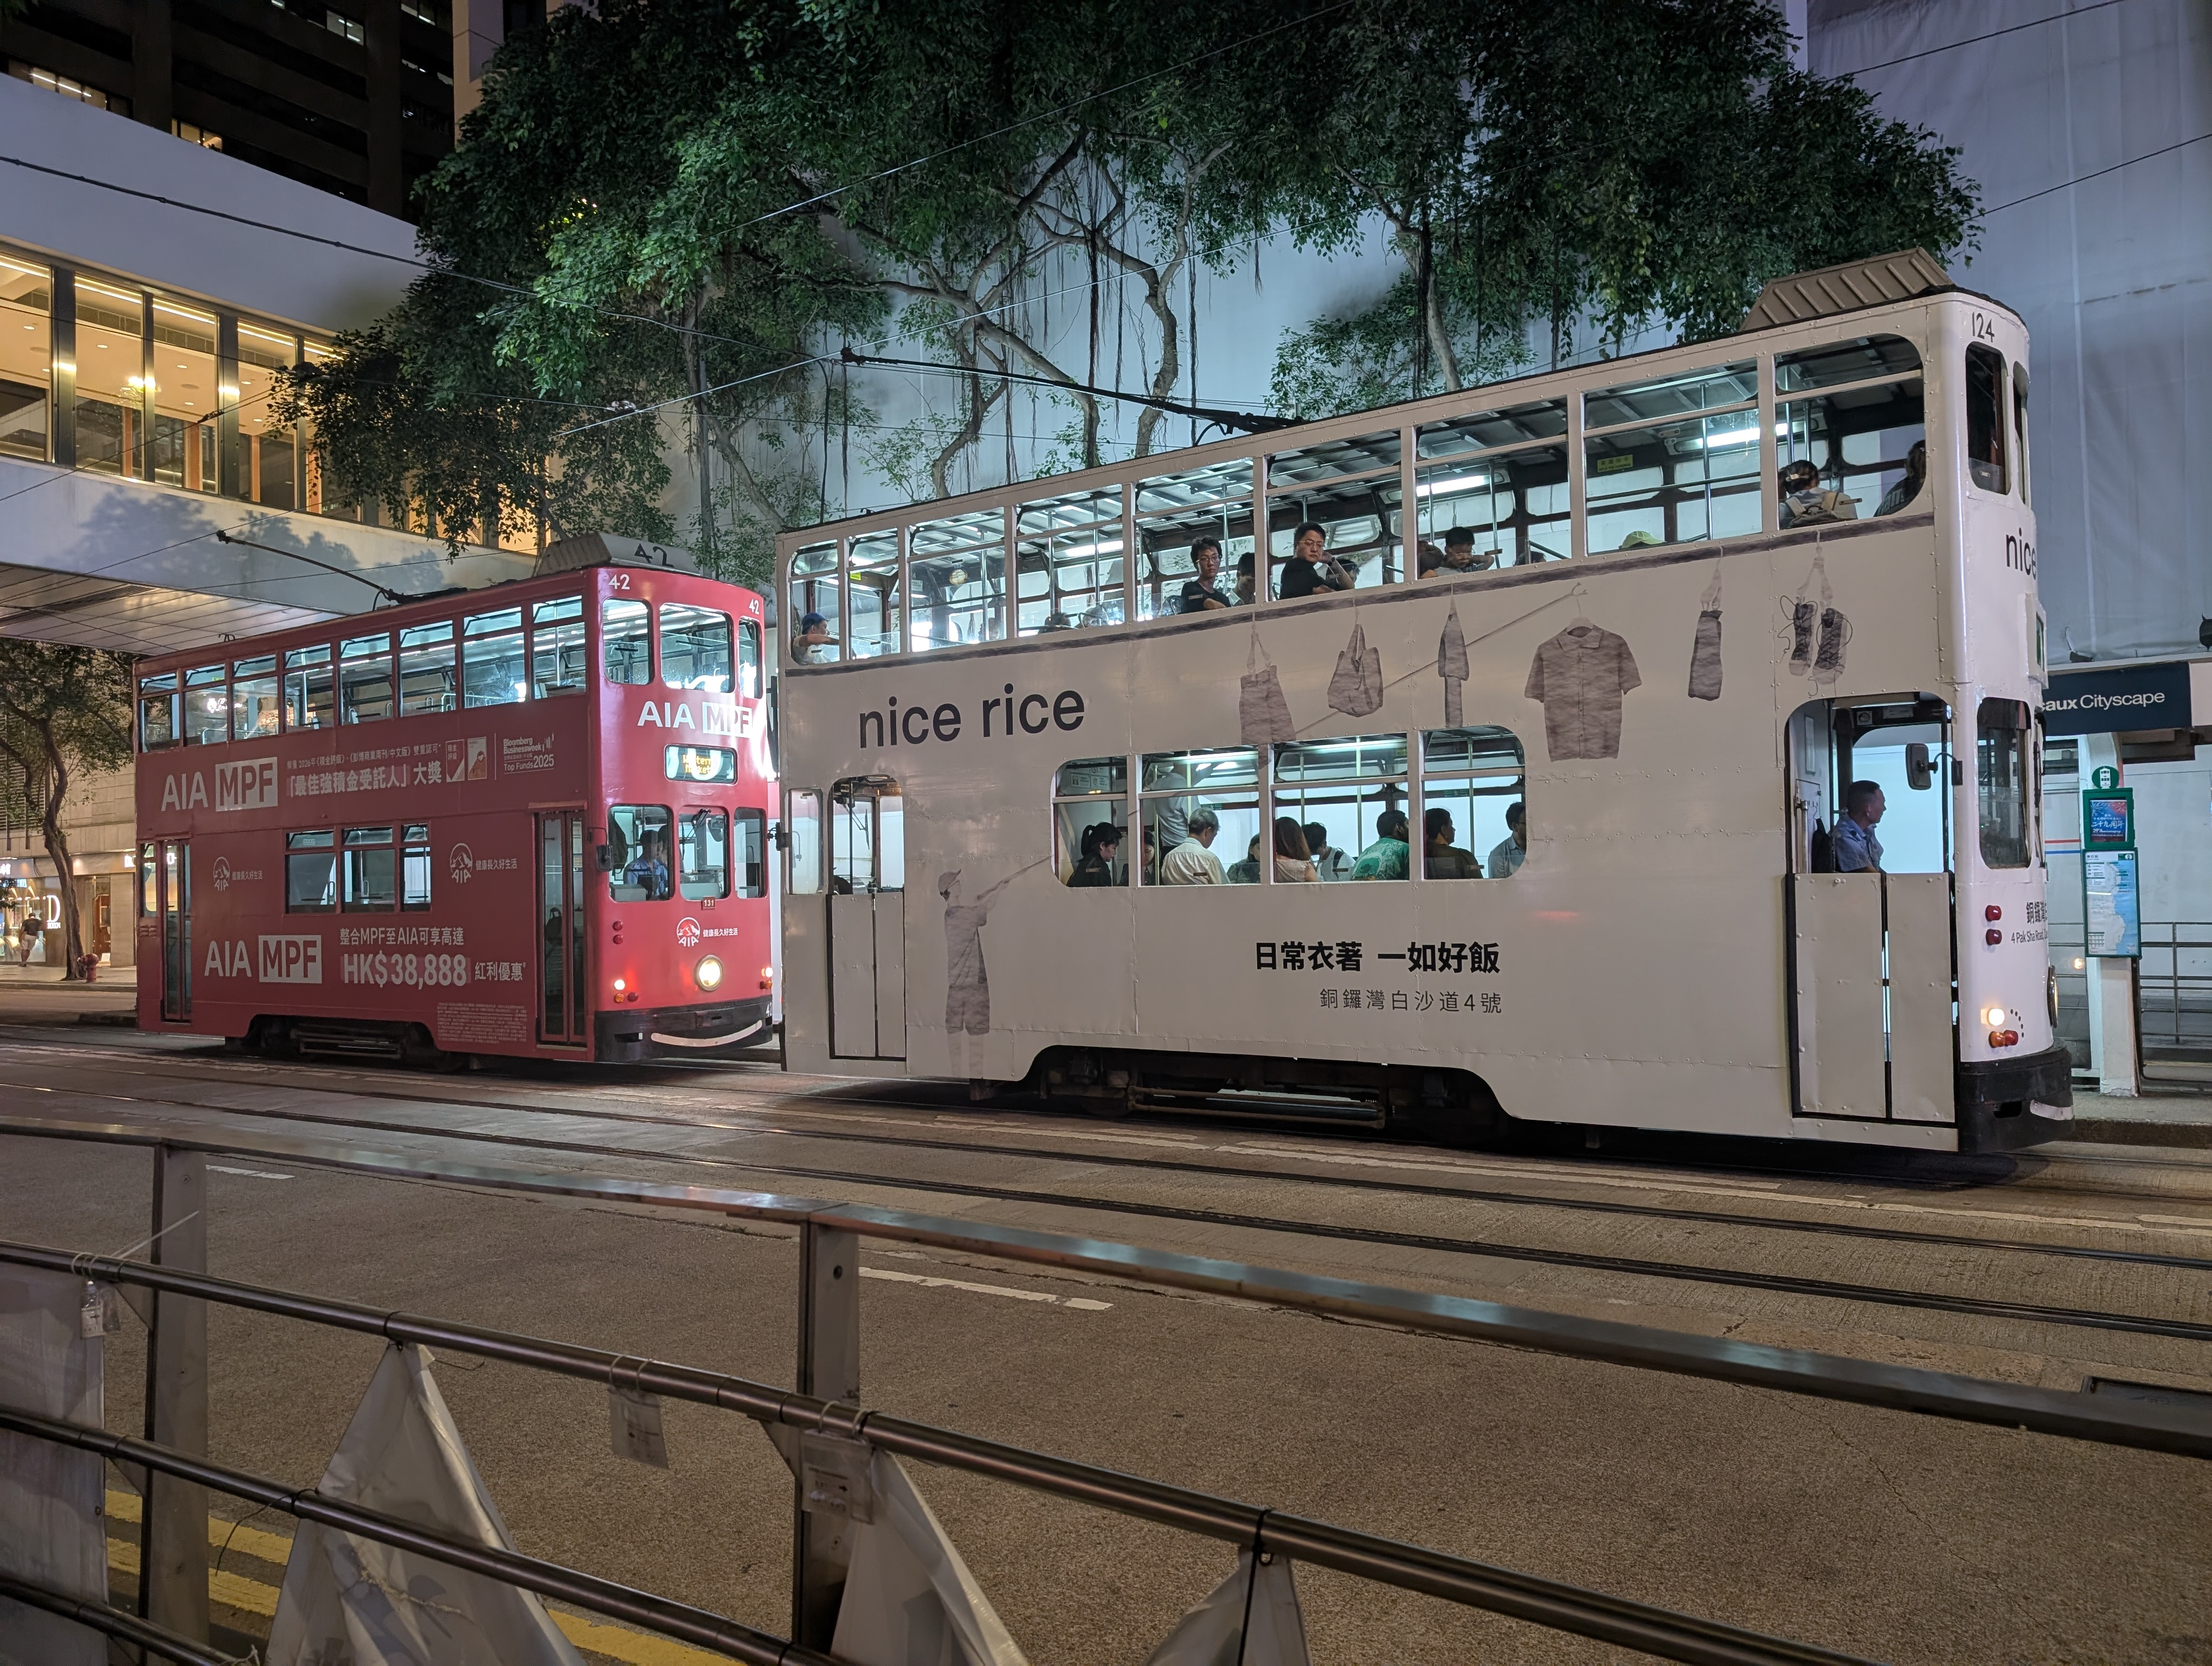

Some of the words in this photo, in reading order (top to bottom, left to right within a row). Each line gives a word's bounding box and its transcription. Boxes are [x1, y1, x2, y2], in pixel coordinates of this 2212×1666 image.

[1972, 312, 1995, 343] 124
[634, 543, 674, 568] 42
[2006, 527, 2036, 580] nice
[608, 574, 630, 589] 42
[748, 599, 759, 614] 42
[2080, 692, 2165, 710] Cityscape
[638, 701, 696, 729] AIA
[706, 706, 749, 734] MPF
[860, 696, 961, 748] nice
[982, 683, 1085, 738] rice
[503, 737, 533, 747] Bloomberg
[503, 743, 542, 754] Businessweek
[516, 761, 533, 770] Funds
[533, 754, 554, 768] 2025
[161, 772, 209, 811] AIA
[220, 762, 273, 806] MPF
[475, 858, 517, 870] 健康長久好生活
[452, 869, 471, 883] AIA
[214, 879, 228, 892] AIA
[340, 926, 465, 946] 整合MPF至AIA可享高達
[703, 928, 738, 938] 健康長久好生活
[2011, 932, 2015, 944] 4
[2016, 931, 2026, 943] Pak
[2027, 930, 2035, 942] Sha
[678, 937, 699, 947] AIA
[204, 940, 252, 977] AIA
[262, 940, 317, 978] MPF
[1256, 941, 1363, 972] 日常衣著
[1378, 941, 1500, 973] 一如好飯
[1319, 988, 1502, 1014] 銅鑼灣白沙道4號
